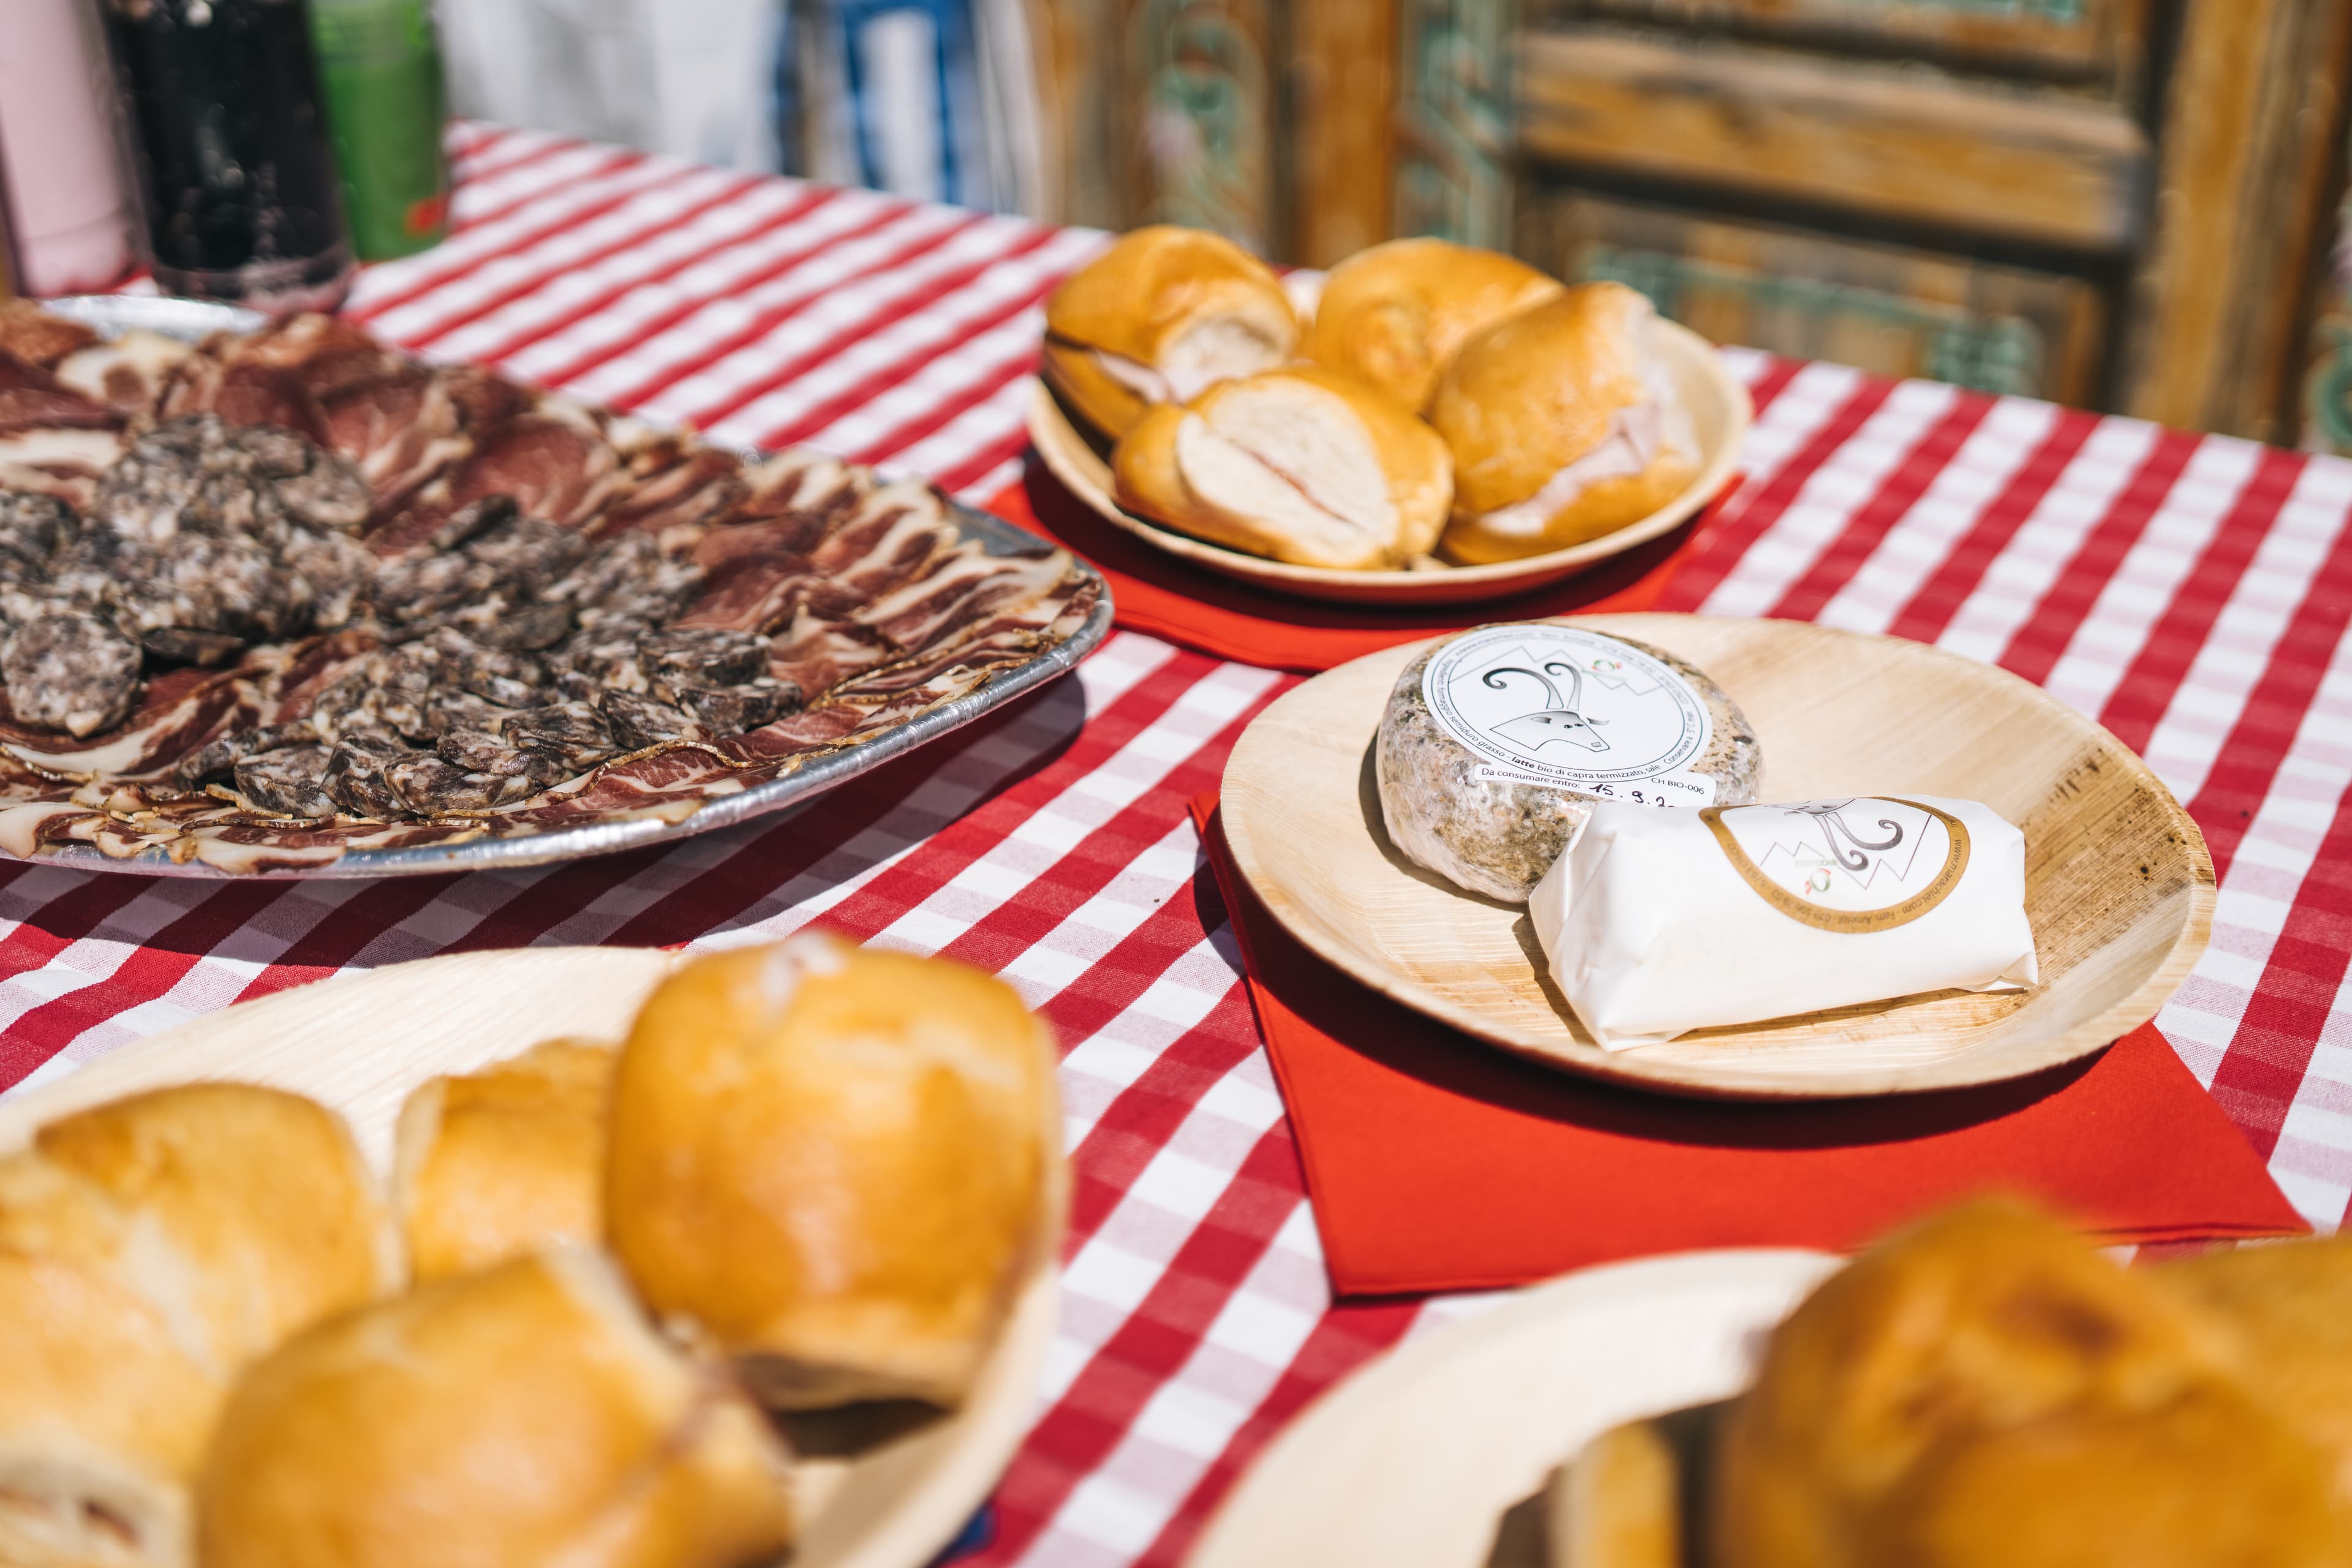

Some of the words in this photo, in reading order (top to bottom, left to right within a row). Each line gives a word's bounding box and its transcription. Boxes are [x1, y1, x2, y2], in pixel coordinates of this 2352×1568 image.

[1437, 687, 1452, 715] formaggio
[1449, 715, 1479, 741] semiduro
[1477, 741, 1505, 756] grasso
[1512, 756, 1535, 769] latte
[1537, 764, 1553, 773] bio
[1555, 767, 1564, 775] di
[1596, 770, 1646, 779] termizzato,
[1646, 764, 1661, 774] sale
[1664, 741, 1692, 764] Conservare
[1482, 767, 1494, 776] Da
[1497, 770, 1550, 783] consumare
[1552, 778, 1580, 789] entro:
[1667, 780, 1705, 794] BIO-006
